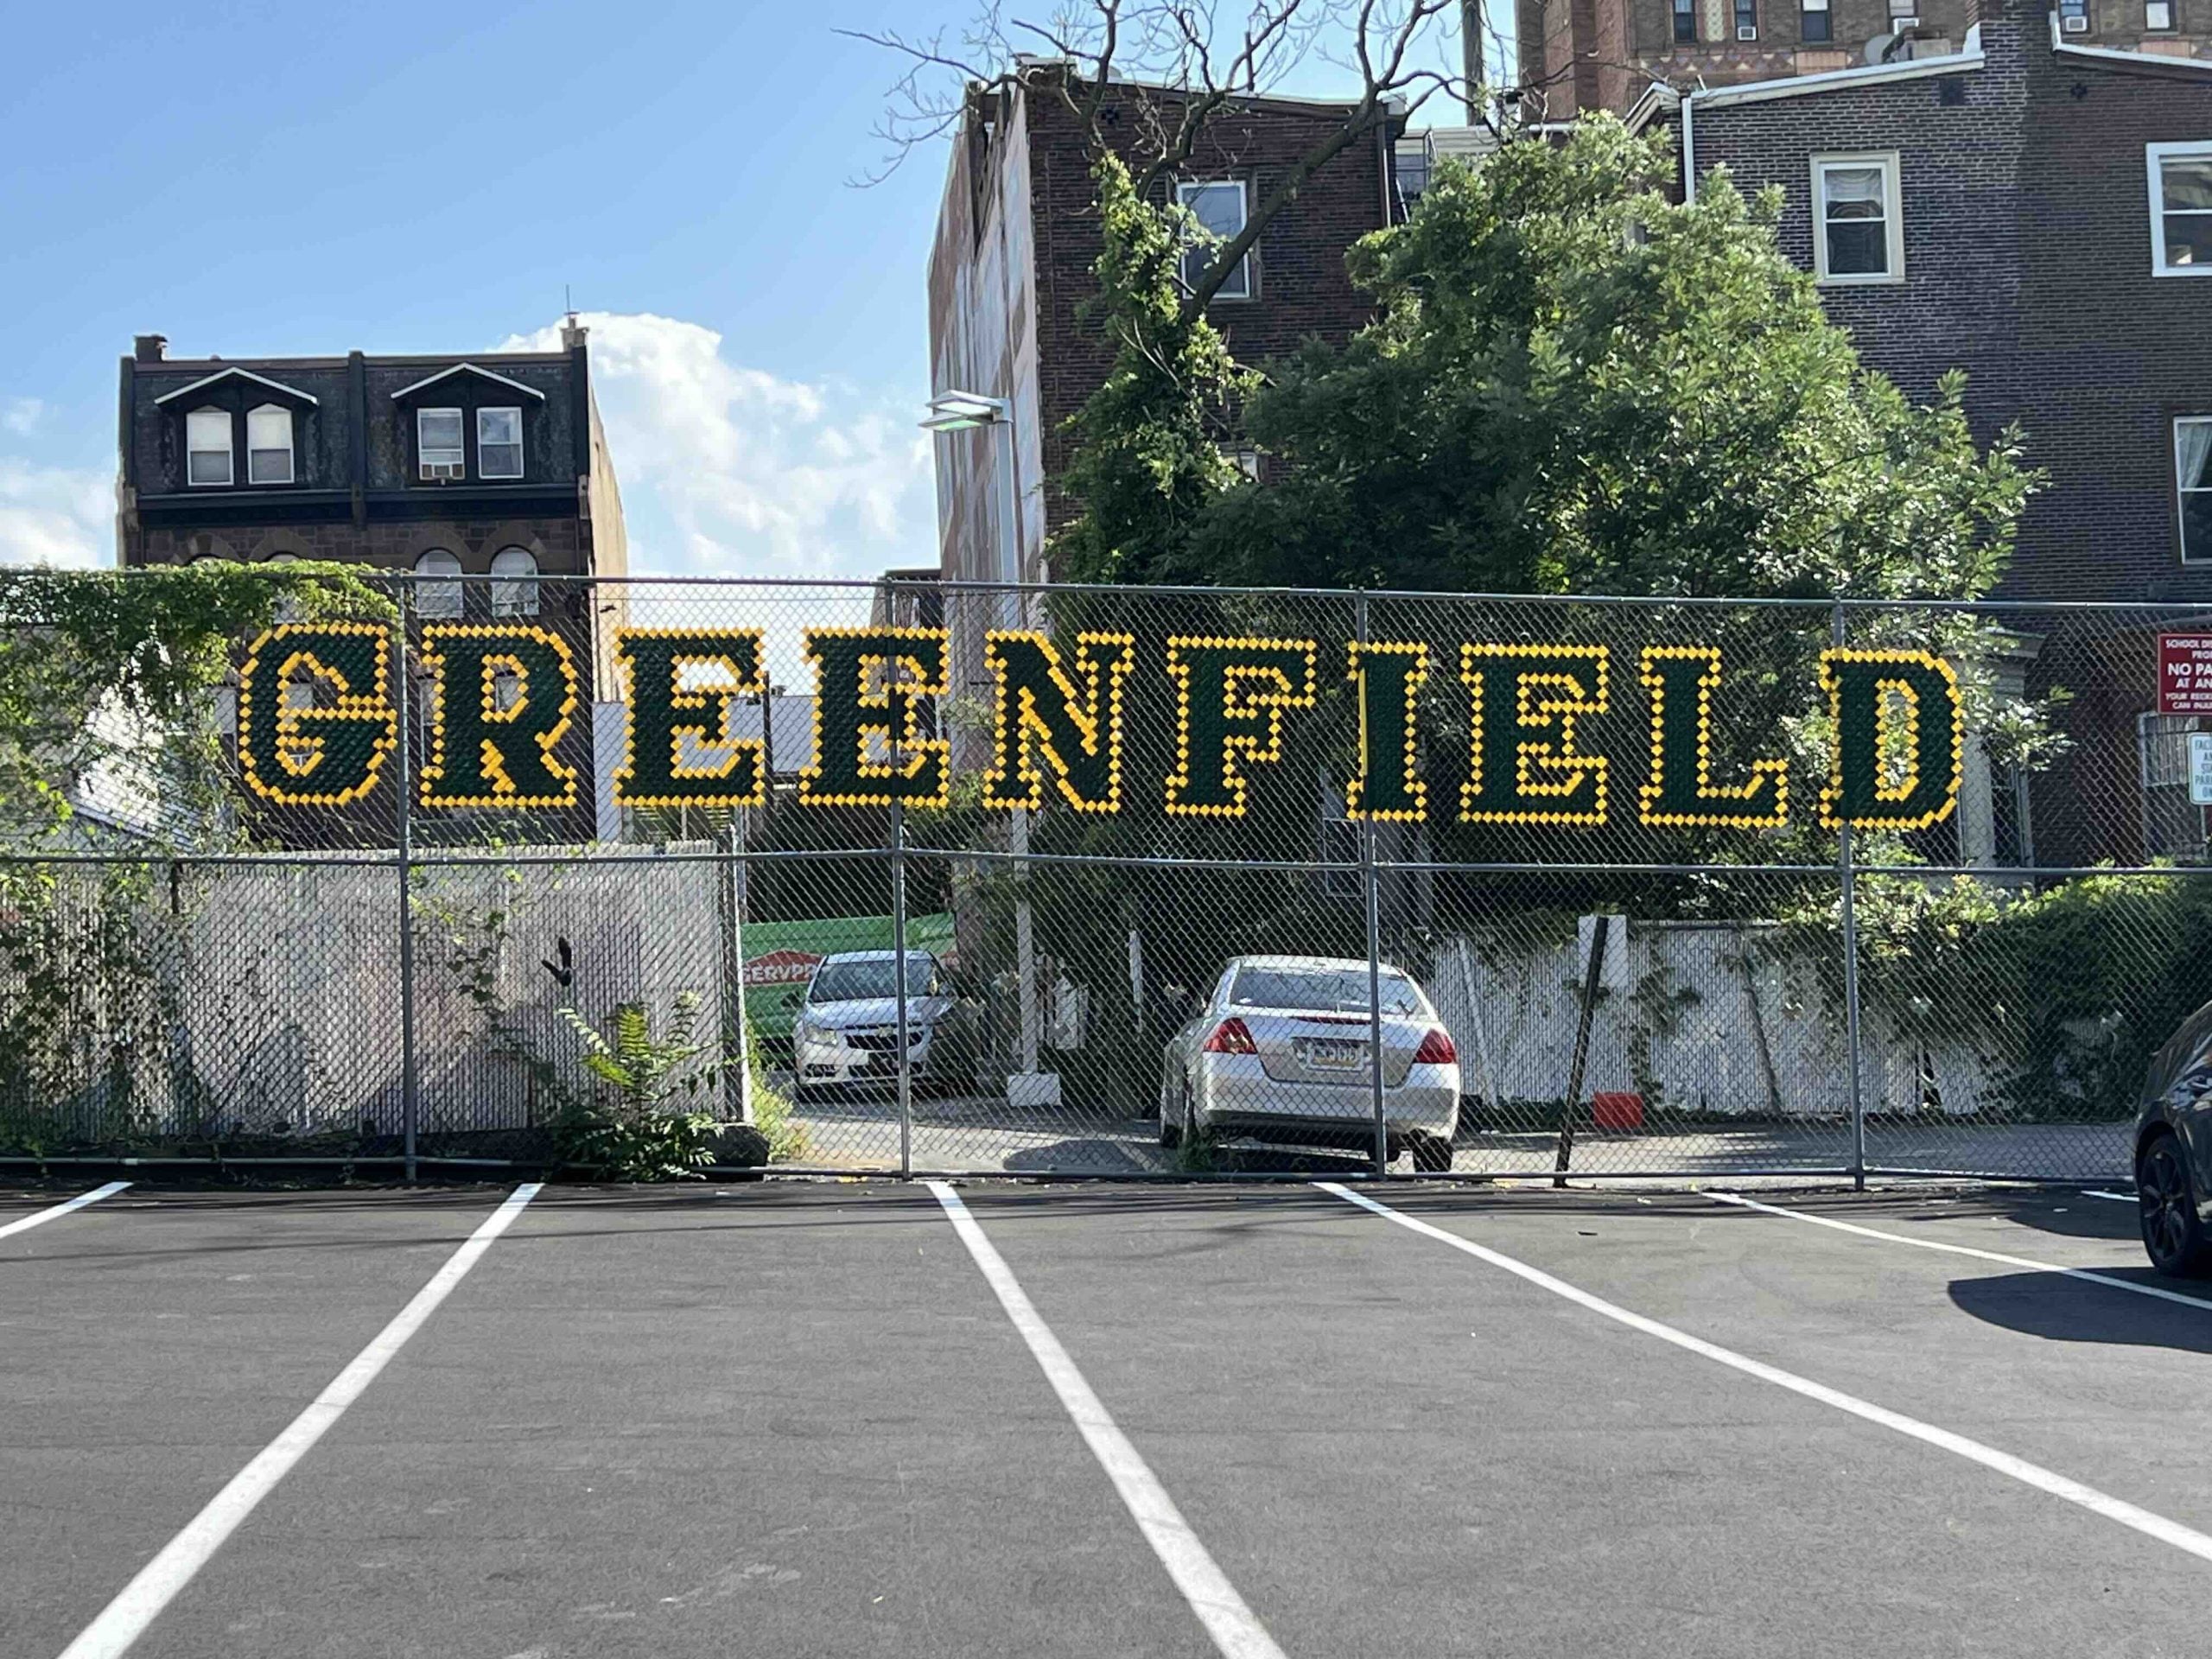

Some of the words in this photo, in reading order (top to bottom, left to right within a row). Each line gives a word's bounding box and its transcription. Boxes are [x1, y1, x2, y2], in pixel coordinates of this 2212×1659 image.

[2165, 639, 2200, 649] SCHOOL
[2168, 663, 2192, 677] NO
[2175, 677, 2190, 689] AT
[2164, 692, 2188, 701] YOUR
[2171, 701, 2191, 710] CAN
[239, 621, 1965, 830] GREENFIELD
[743, 963, 820, 983] SERVPR
